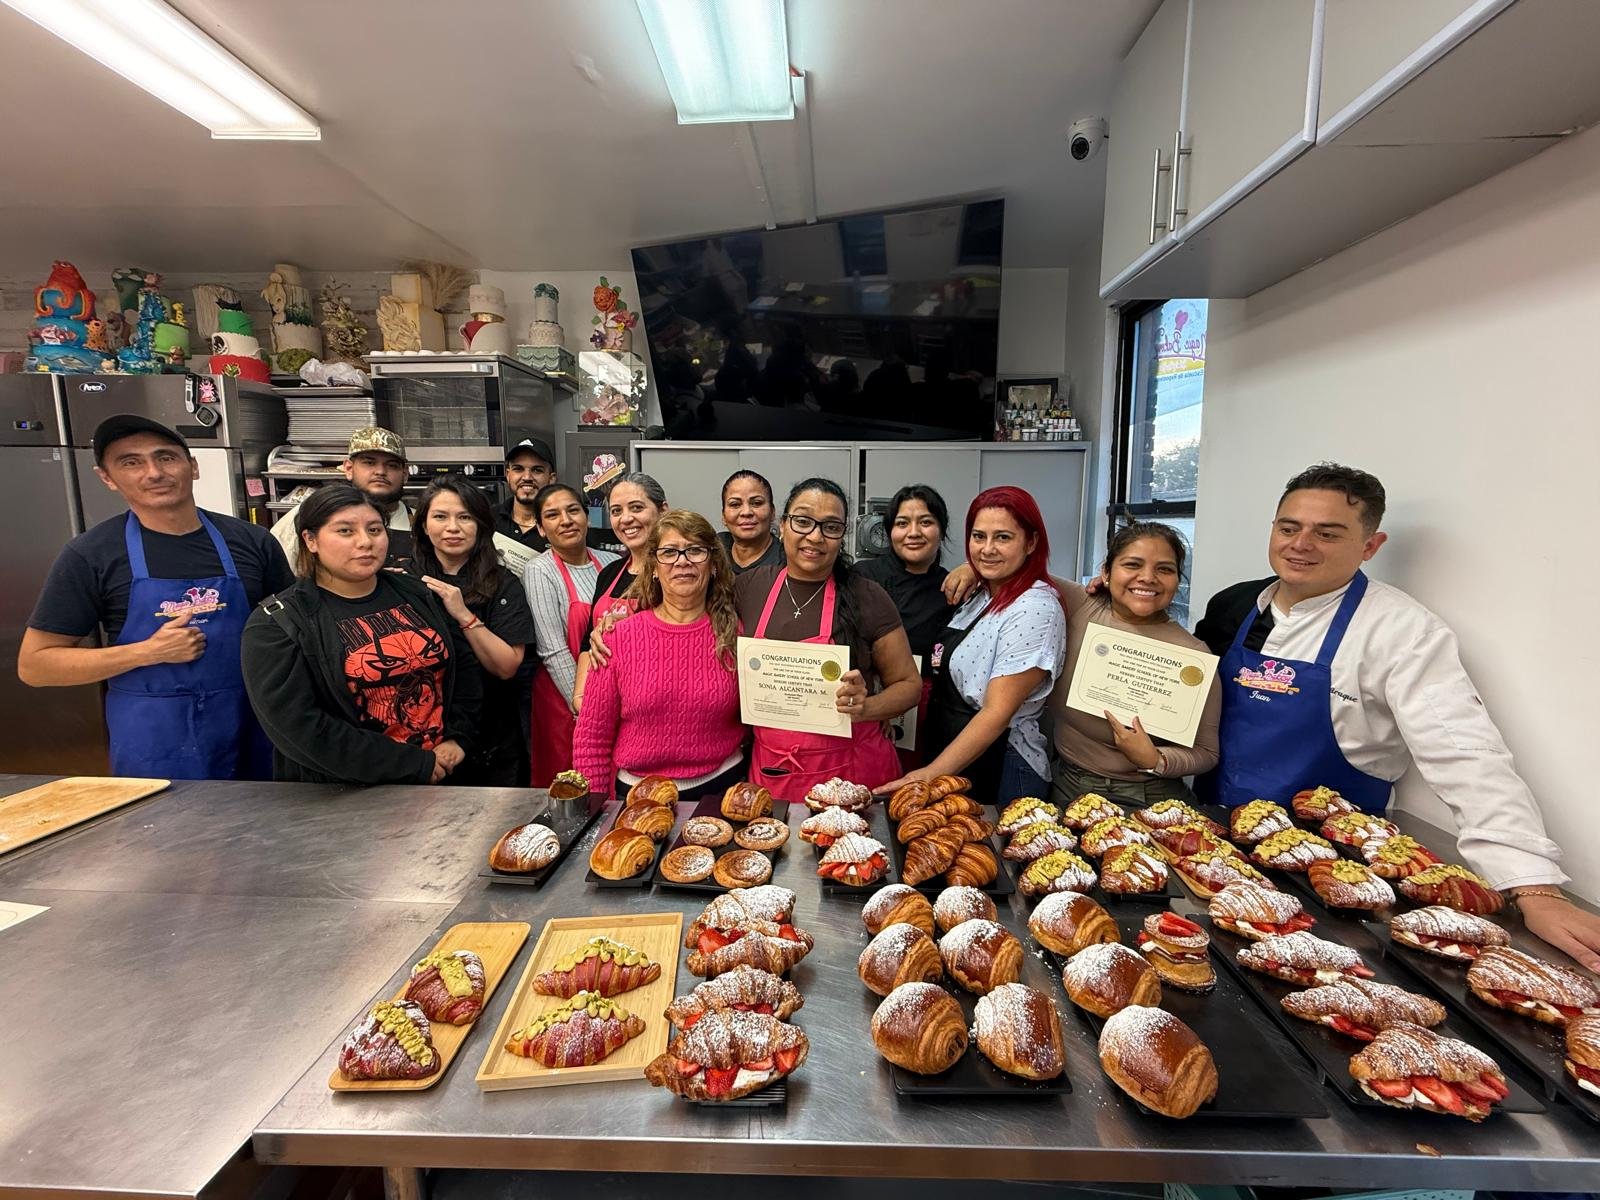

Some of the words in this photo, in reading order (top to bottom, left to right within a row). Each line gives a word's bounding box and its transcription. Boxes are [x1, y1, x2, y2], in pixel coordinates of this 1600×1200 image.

[761, 653, 822, 666] CONGRATULATIONS
[1112, 644, 1183, 668] CONGRATULATIONS
[758, 682, 777, 691] SONIA
[779, 685, 818, 695] ALCANTARA
[1106, 672, 1129, 685] PERLA
[1131, 680, 1173, 697] GUTIERREZ
[1249, 690, 1272, 702] Juan
